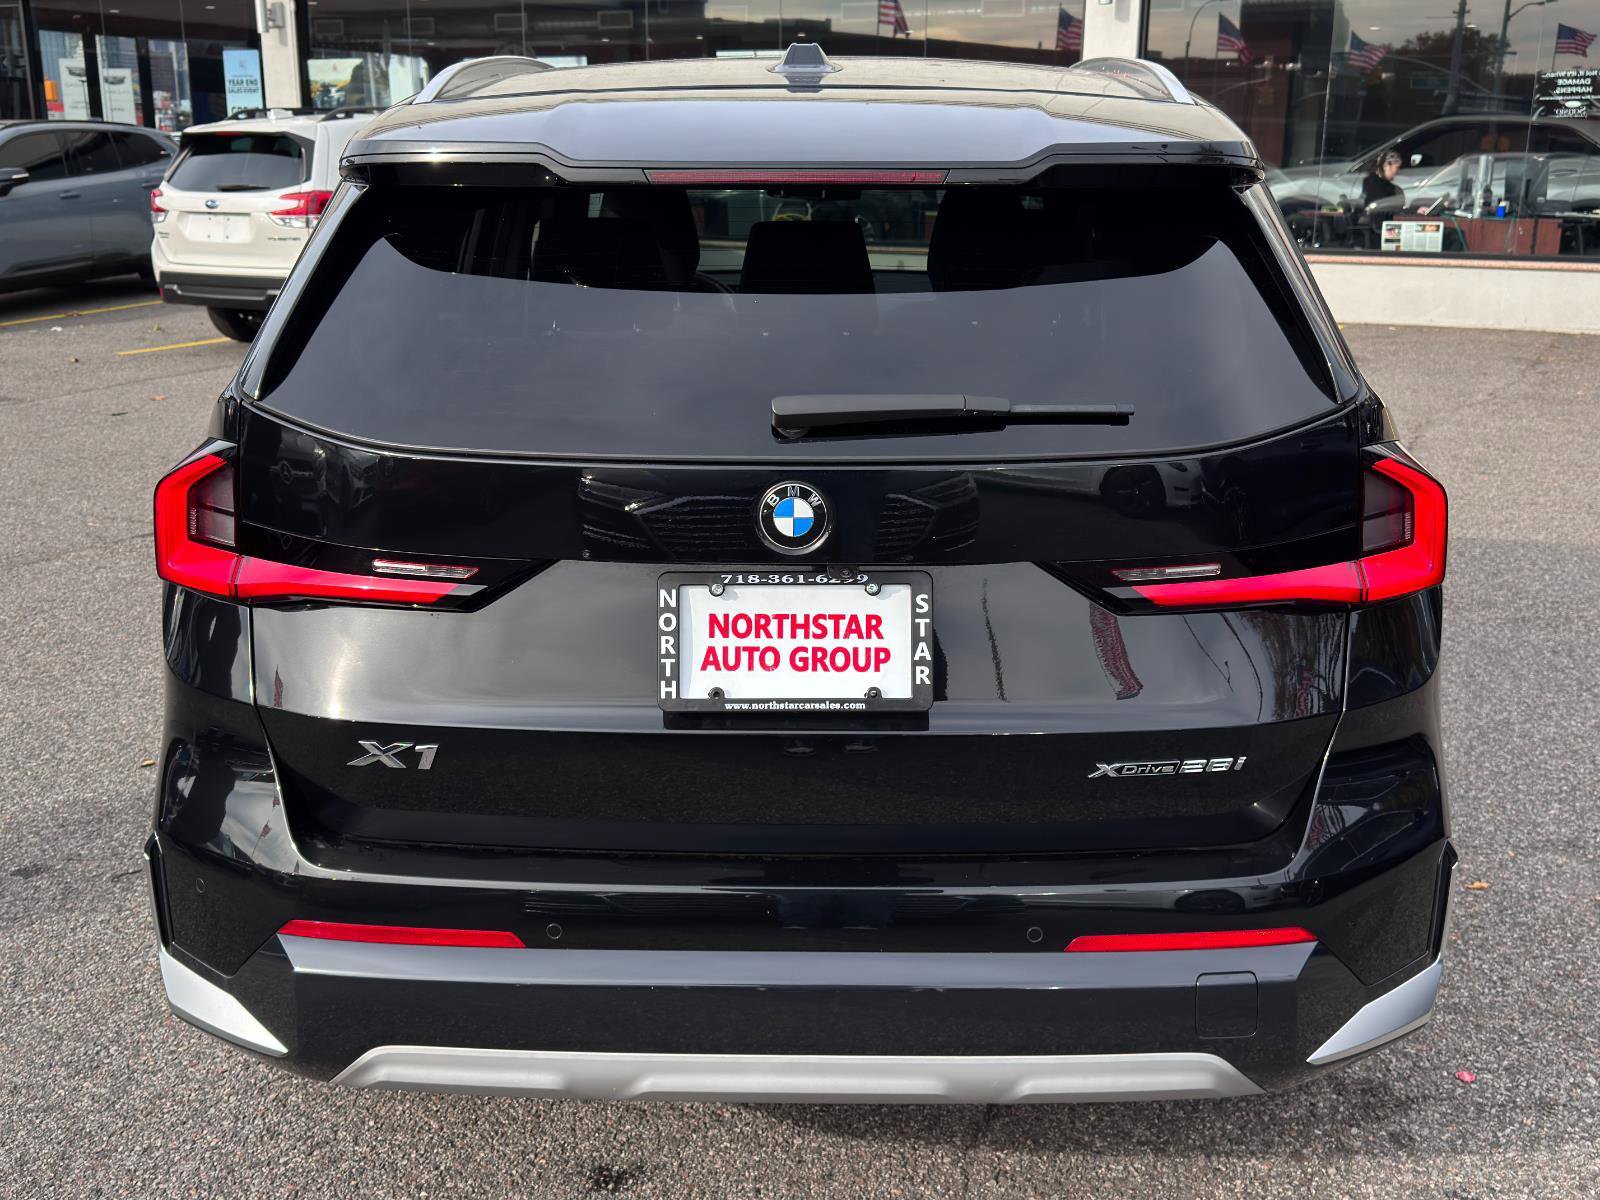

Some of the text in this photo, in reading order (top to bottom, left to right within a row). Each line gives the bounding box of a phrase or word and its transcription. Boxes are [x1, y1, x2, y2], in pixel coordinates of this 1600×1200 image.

[766, 485, 822, 508] BMW
[708, 613, 884, 640] NORTHSTAR
[914, 594, 932, 685] STAR
[659, 589, 677, 699] NORTH
[700, 646, 891, 673] AUTO GROUP
[724, 701, 866, 710] www.northstarcarsales.com
[346, 740, 440, 770] X1
